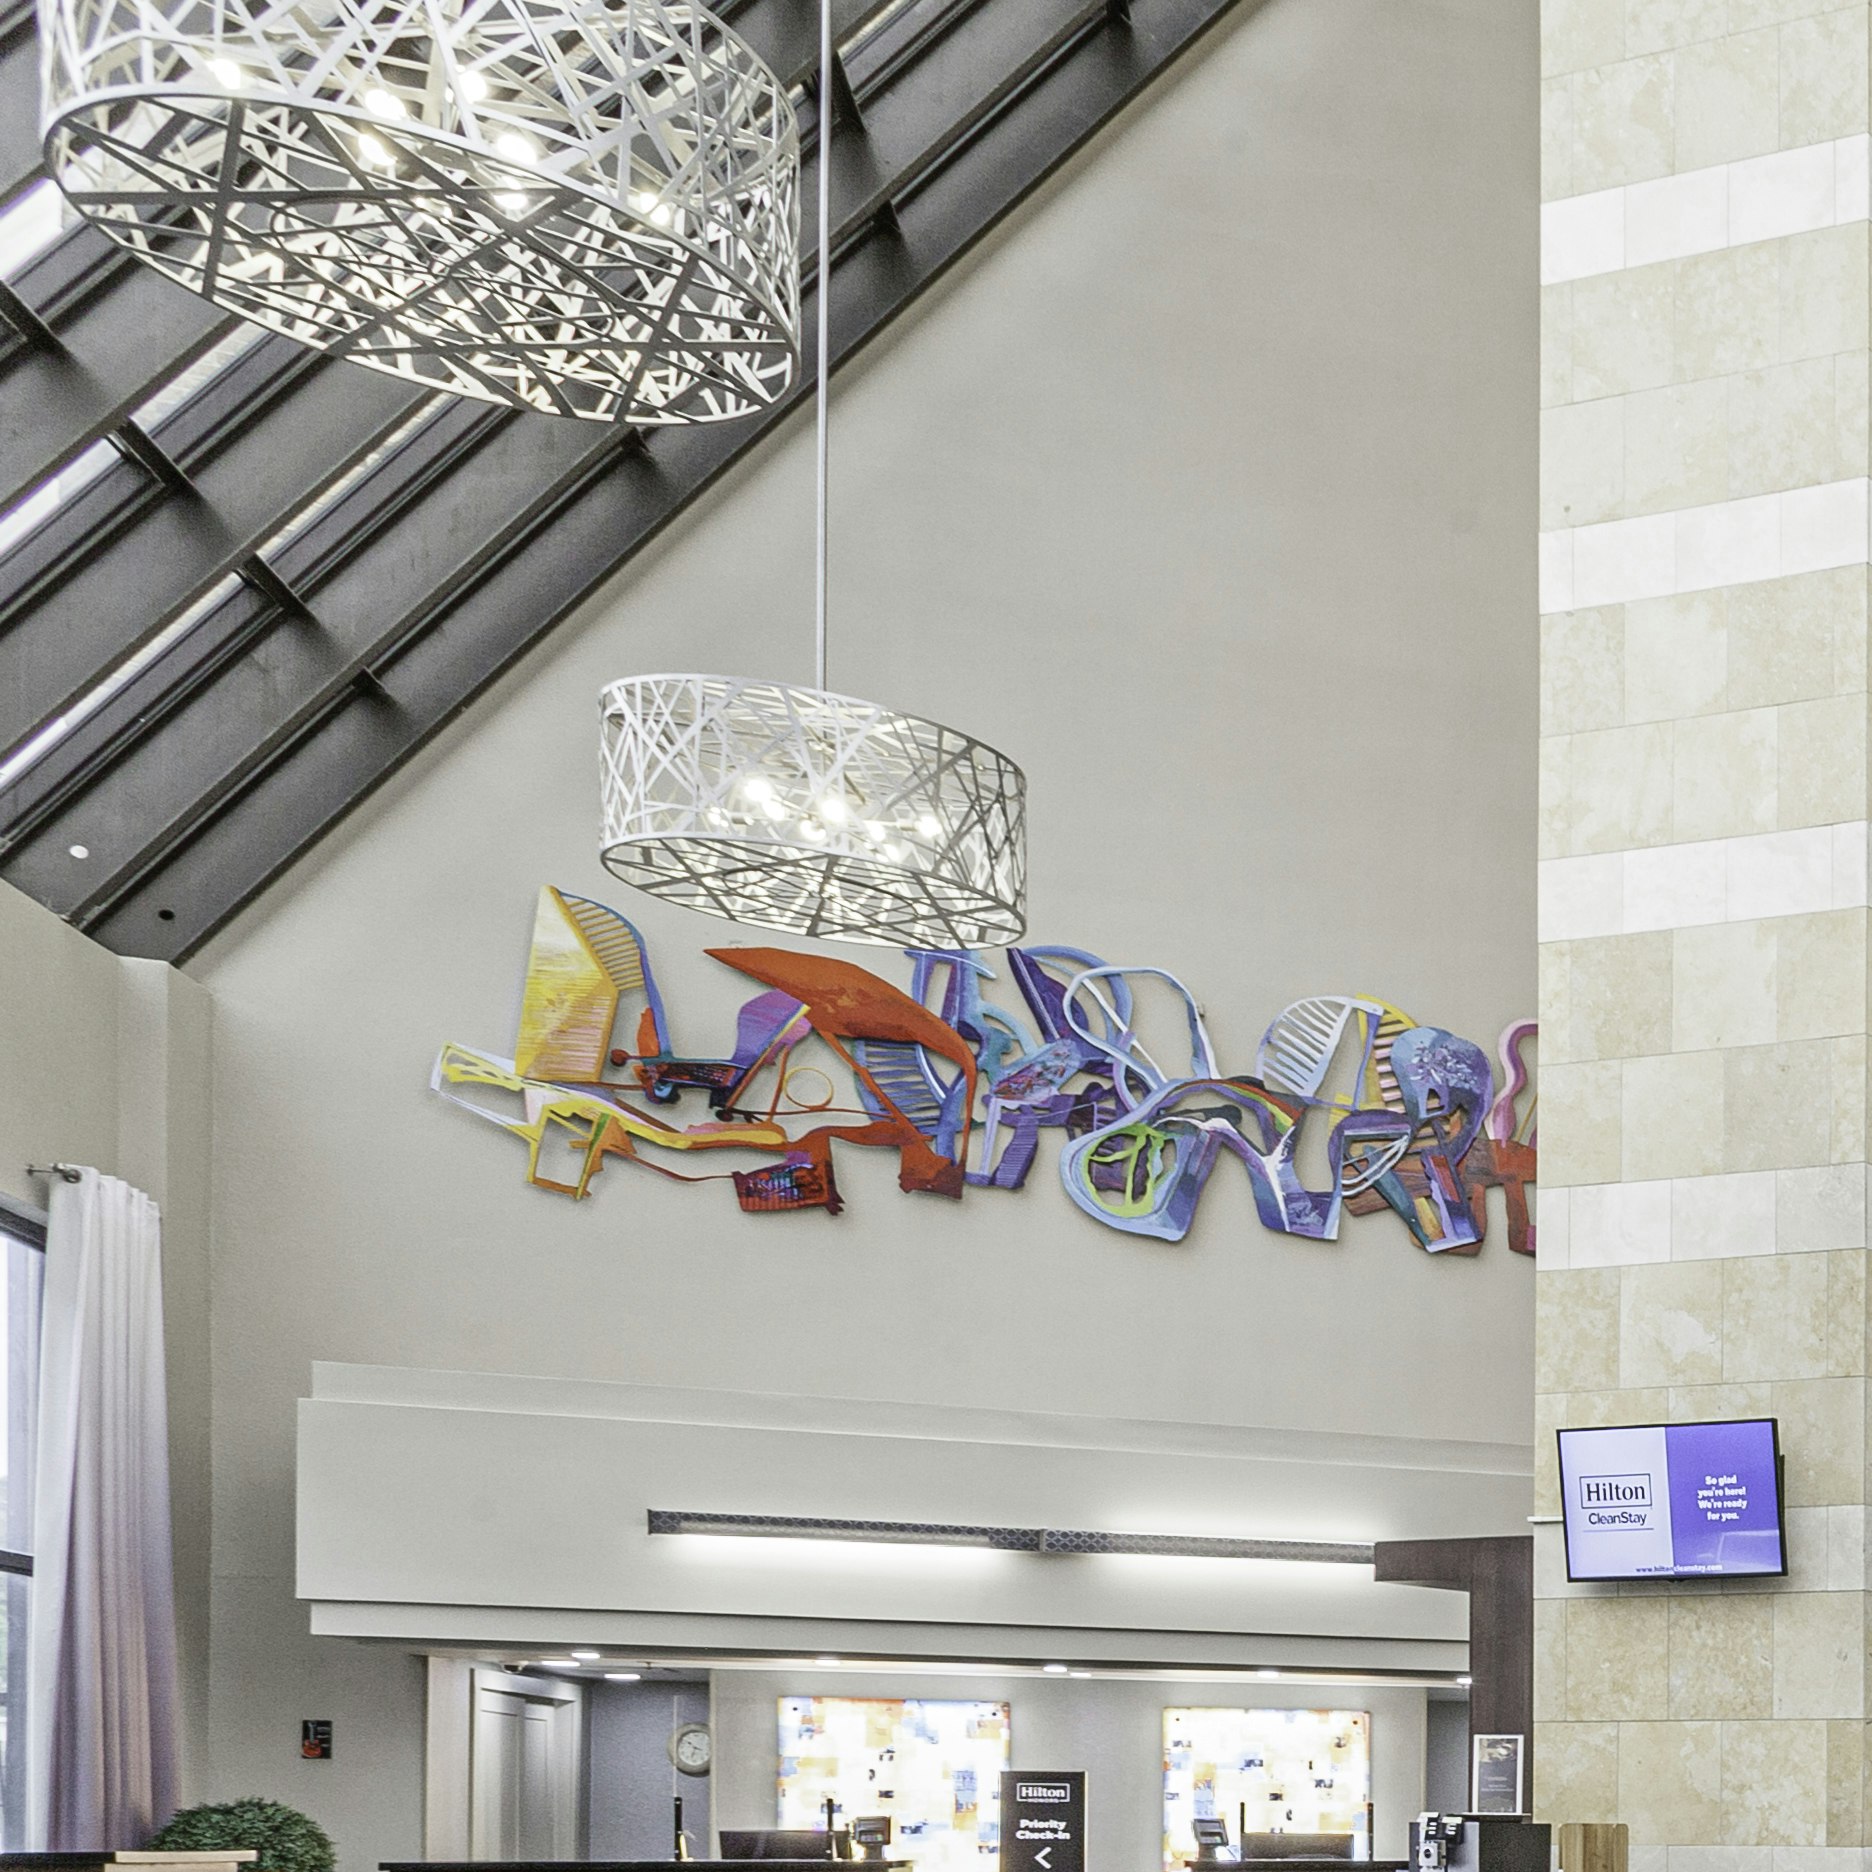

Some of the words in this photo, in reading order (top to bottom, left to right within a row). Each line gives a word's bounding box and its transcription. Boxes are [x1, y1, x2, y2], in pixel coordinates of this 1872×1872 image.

[1705, 1475, 1717, 1485] So
[1718, 1474, 1737, 1486] glad
[1586, 1482, 1646, 1502] Hilton
[1697, 1486, 1724, 1499] you're
[1724, 1486, 1746, 1496] here!
[1697, 1498, 1722, 1509] We're
[1723, 1498, 1747, 1510] ready
[1588, 1511, 1647, 1526] CleanStay
[1707, 1511, 1720, 1521] for
[1721, 1512, 1740, 1522] you.
[1021, 1786, 1066, 1798] Hilton
[1020, 1818, 1067, 1831] Priority
